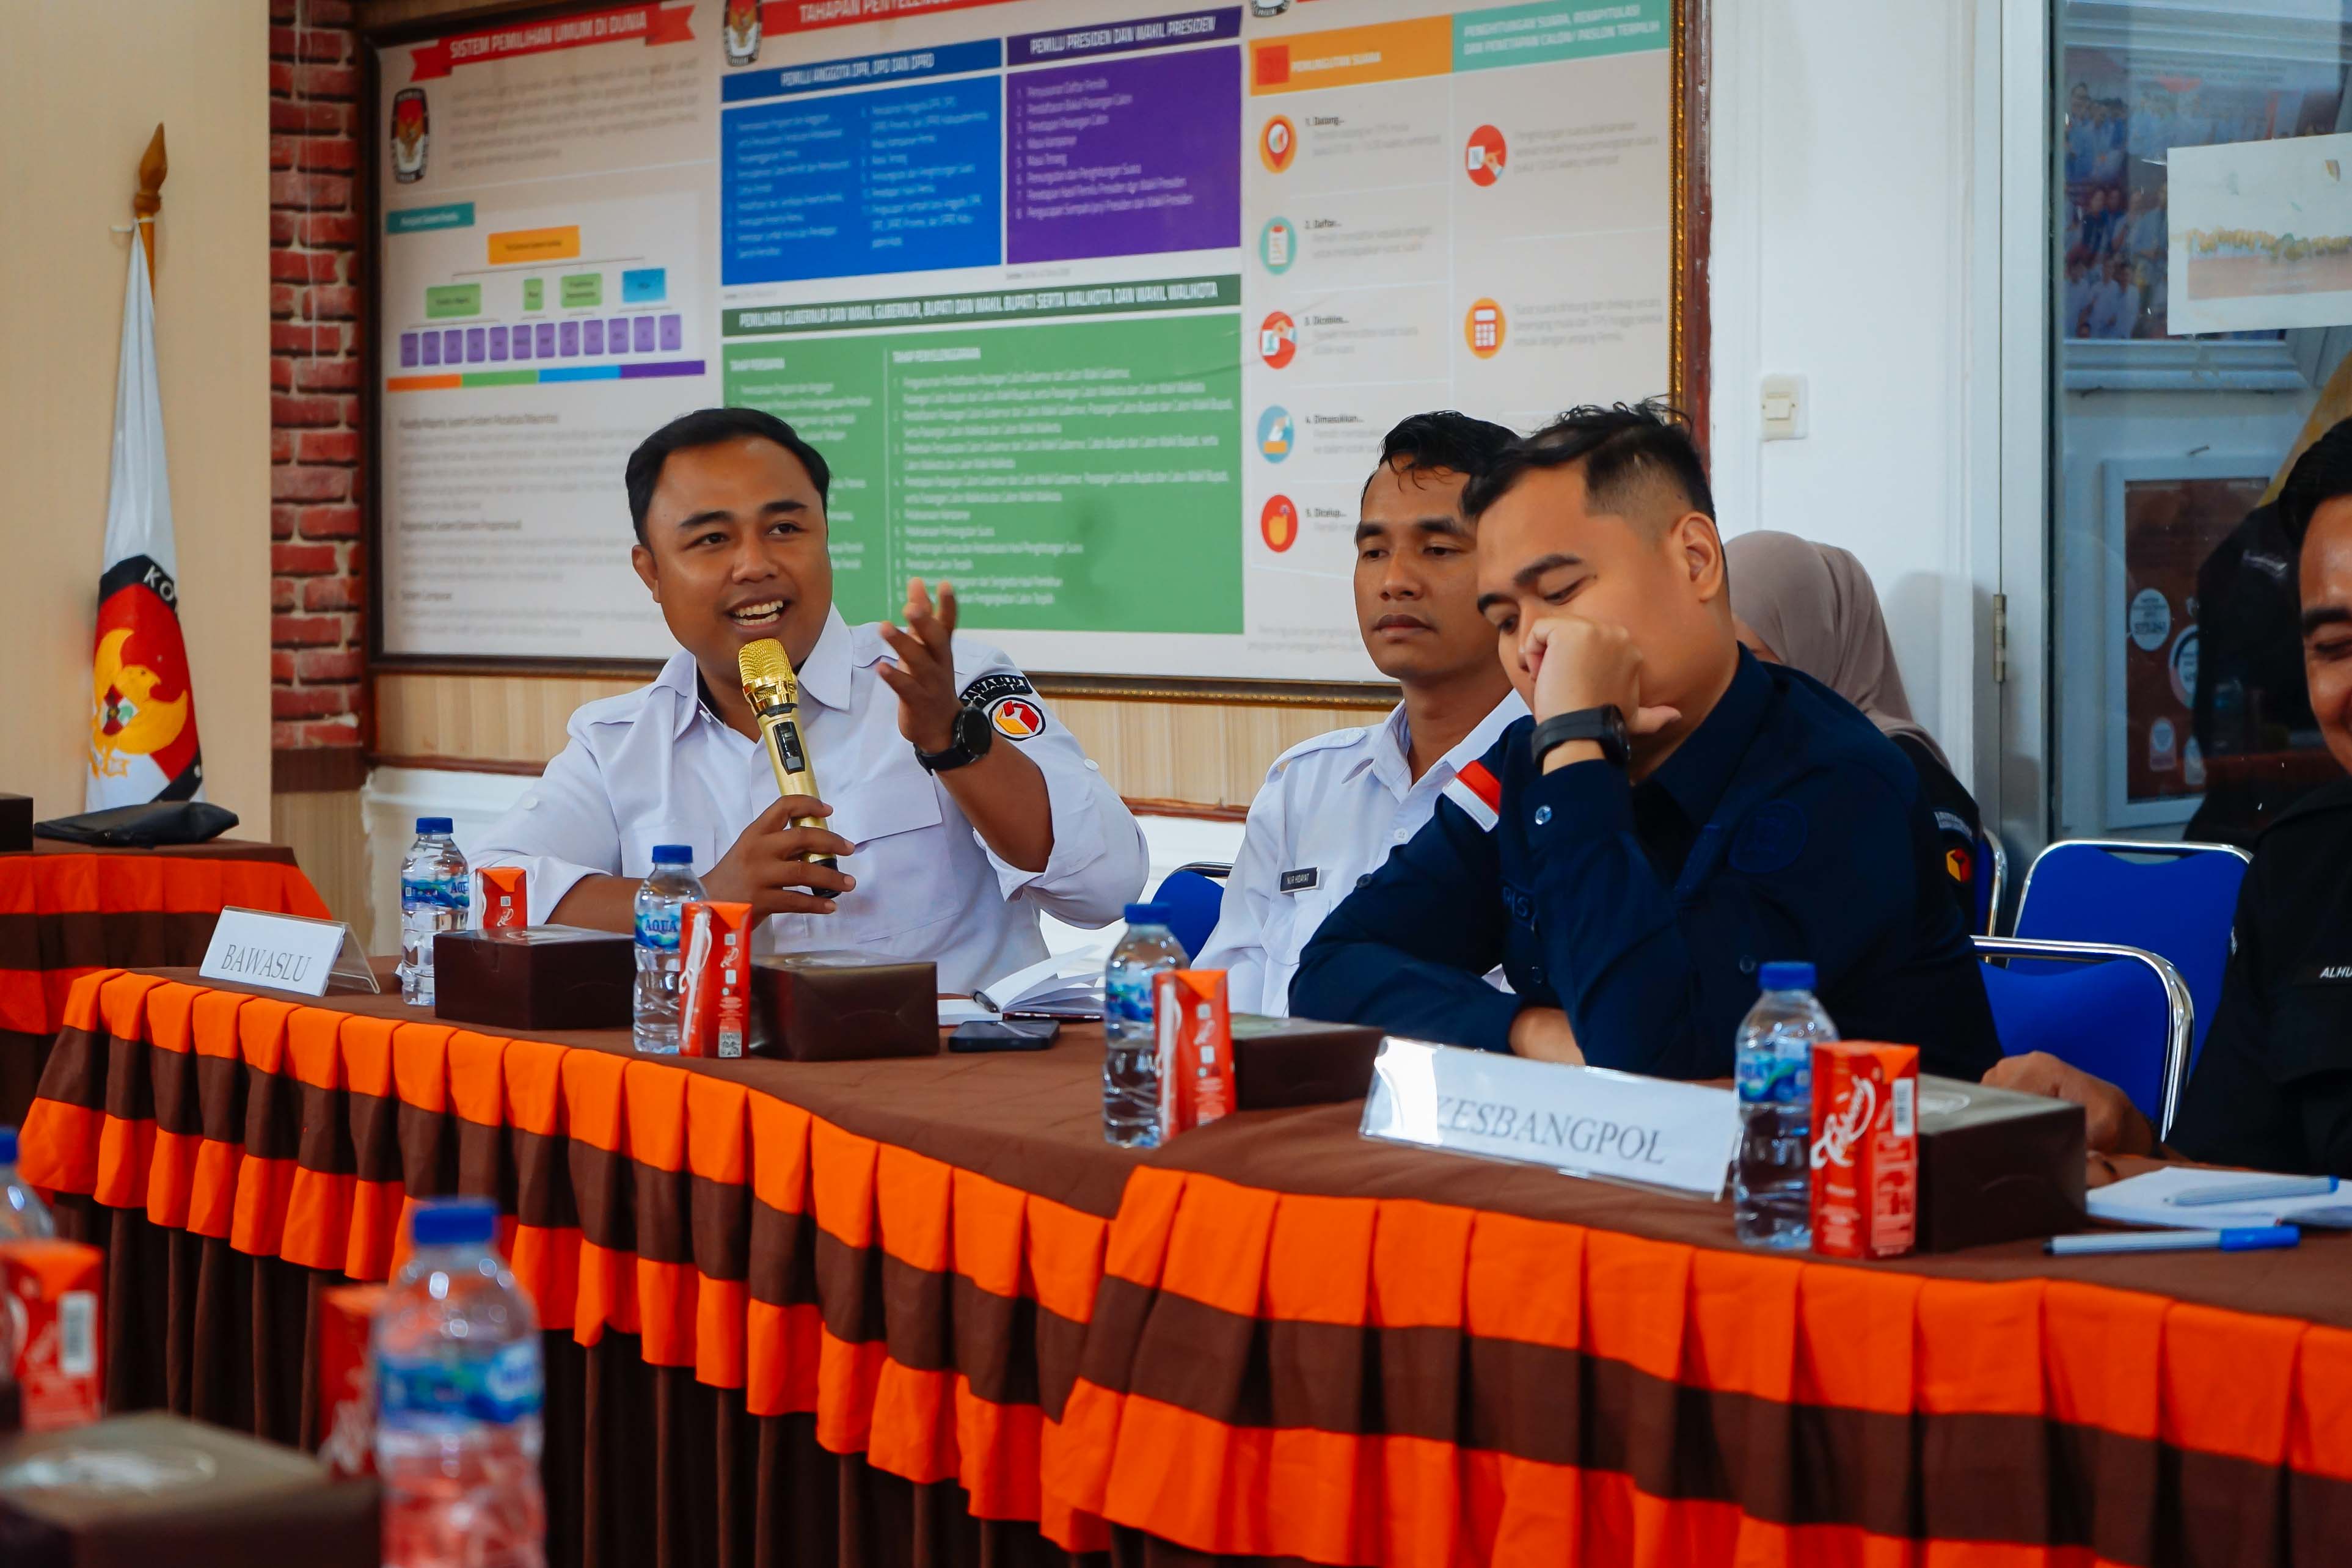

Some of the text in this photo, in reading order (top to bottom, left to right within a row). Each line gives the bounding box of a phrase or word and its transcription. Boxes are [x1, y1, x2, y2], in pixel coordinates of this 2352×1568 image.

[799, 0, 860, 23] TAHAPAN
[450, 10, 647, 59] SISTEM PEMILIHAN UMUM DI DUNIA
[1030, 16, 1217, 54] PEMILU PRESIDEN DAN WAKIL PRESIDEN
[645, 919, 679, 935] AQUA
[221, 944, 312, 982] BAWASLU
